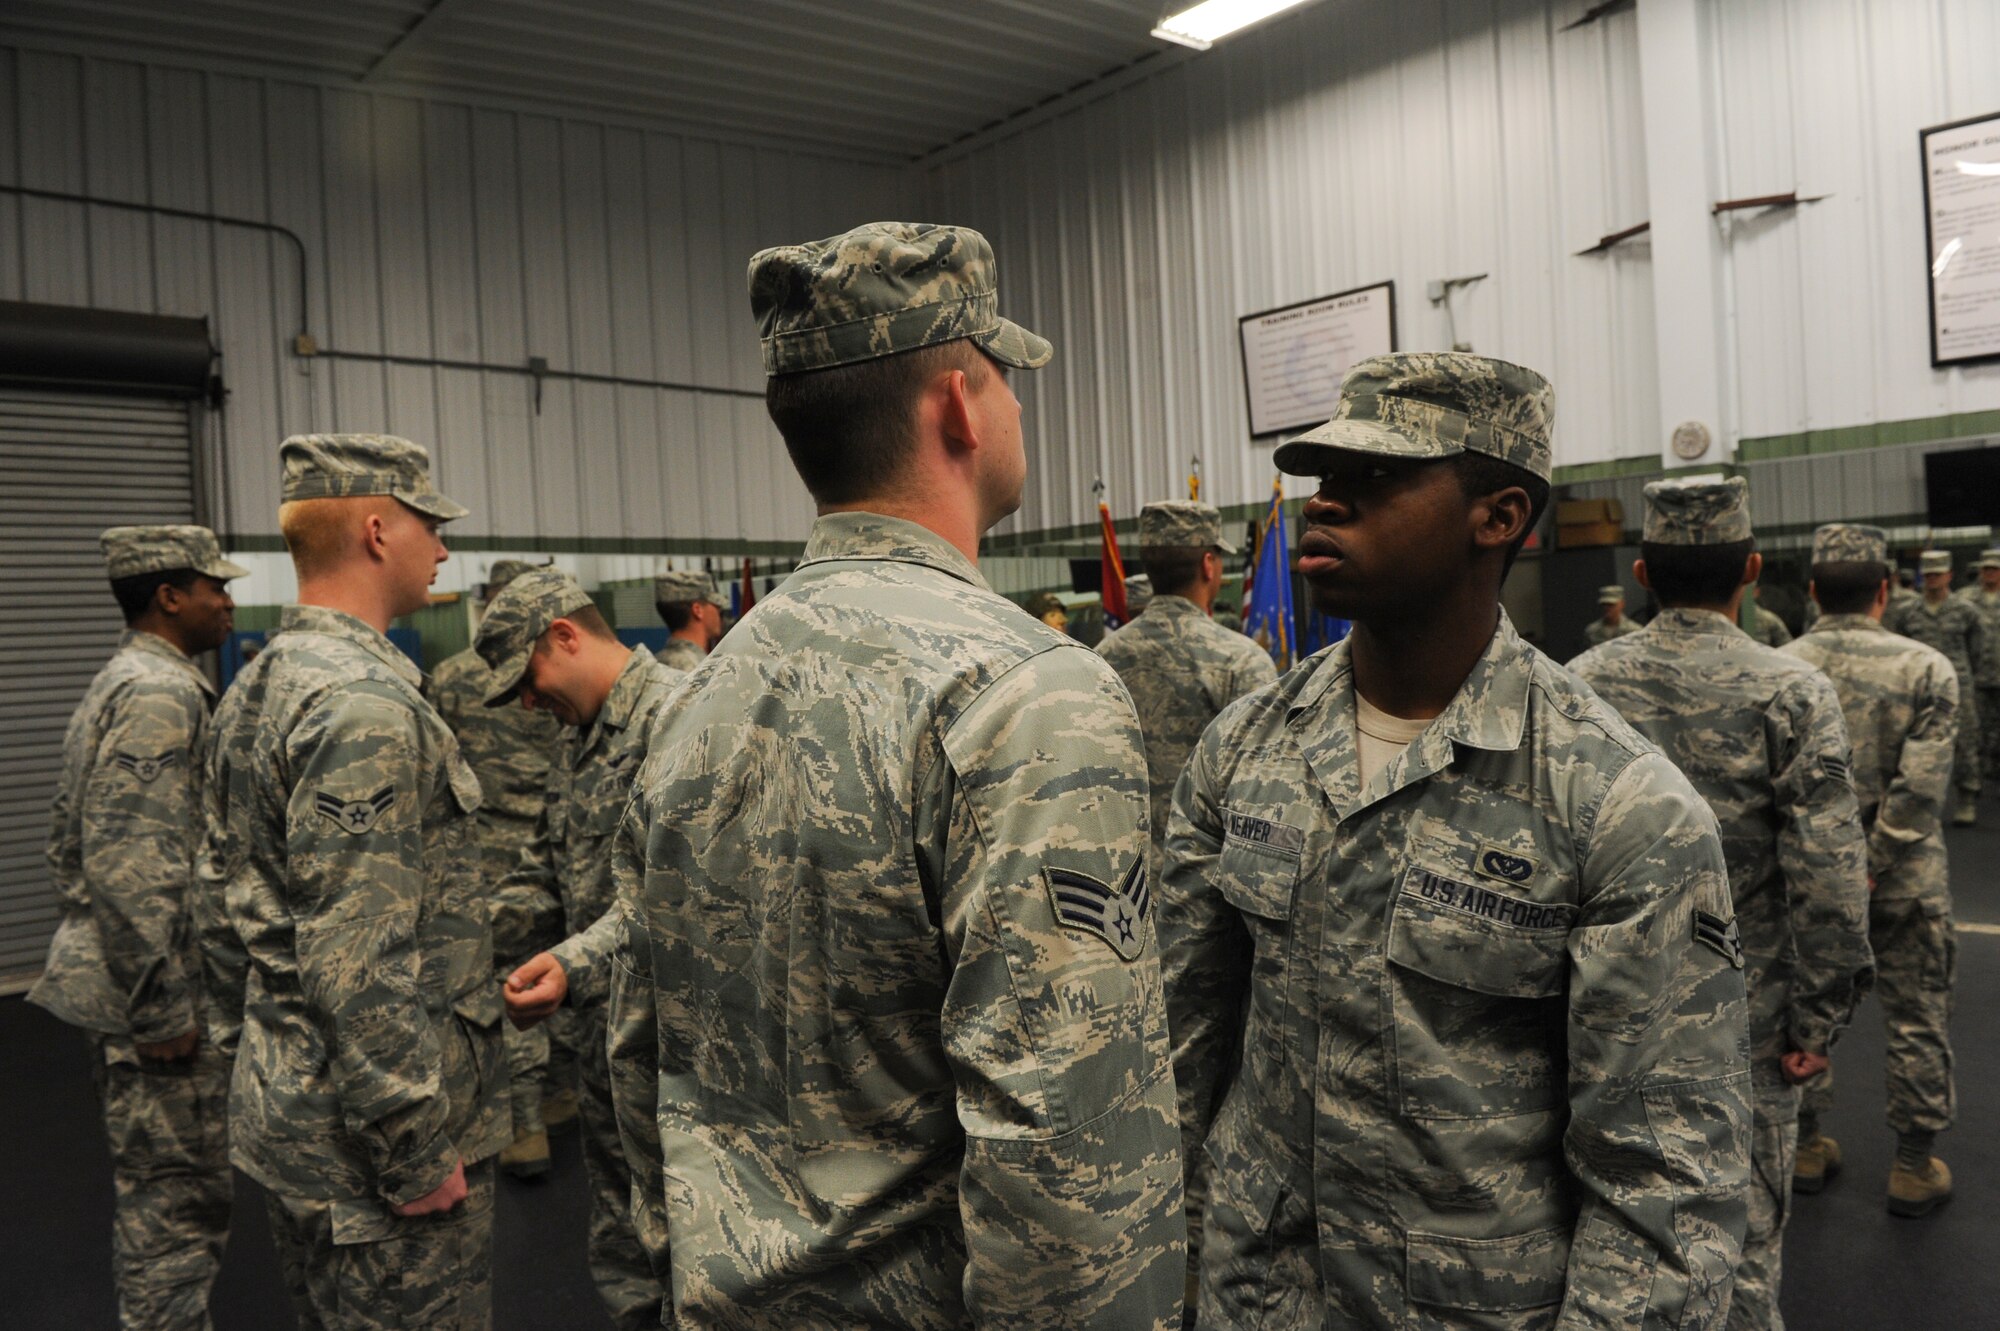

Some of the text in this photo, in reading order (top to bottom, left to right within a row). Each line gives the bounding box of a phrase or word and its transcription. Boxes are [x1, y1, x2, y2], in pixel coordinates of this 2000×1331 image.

[1420, 873, 1566, 929] U.S. AIR FORCE
